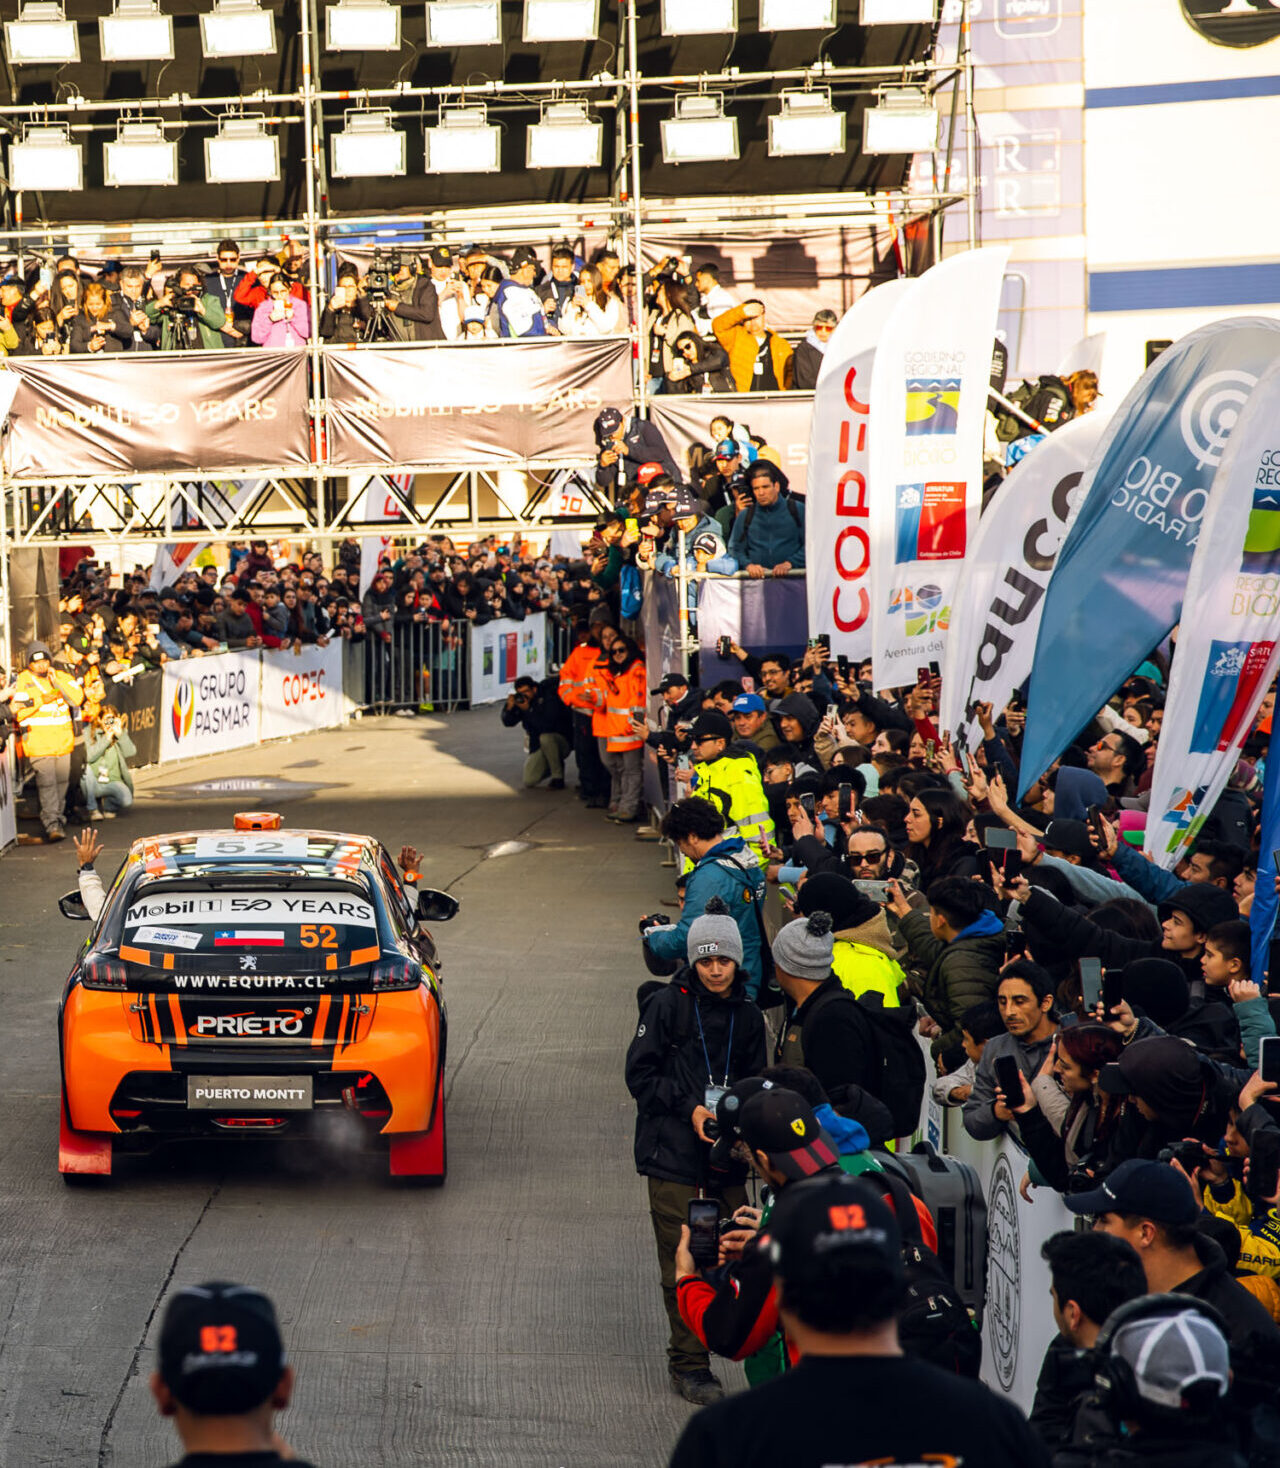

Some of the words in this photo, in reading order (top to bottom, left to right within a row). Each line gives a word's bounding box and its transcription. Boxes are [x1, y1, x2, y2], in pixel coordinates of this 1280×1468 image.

[199, 669, 246, 701] GRUPO
[283, 668, 326, 707] COPEC
[195, 702, 250, 737] PASMAR
[216, 841, 284, 854] 52
[127, 900, 194, 922] Mobil
[282, 899, 371, 920] YEARS
[300, 925, 339, 948] 52
[174, 975, 326, 989] WWW.EQUIPA.CL
[197, 1014, 304, 1036] PRIETO
[195, 1088, 252, 1101] PUERTO
[253, 1088, 306, 1101] MONTT
